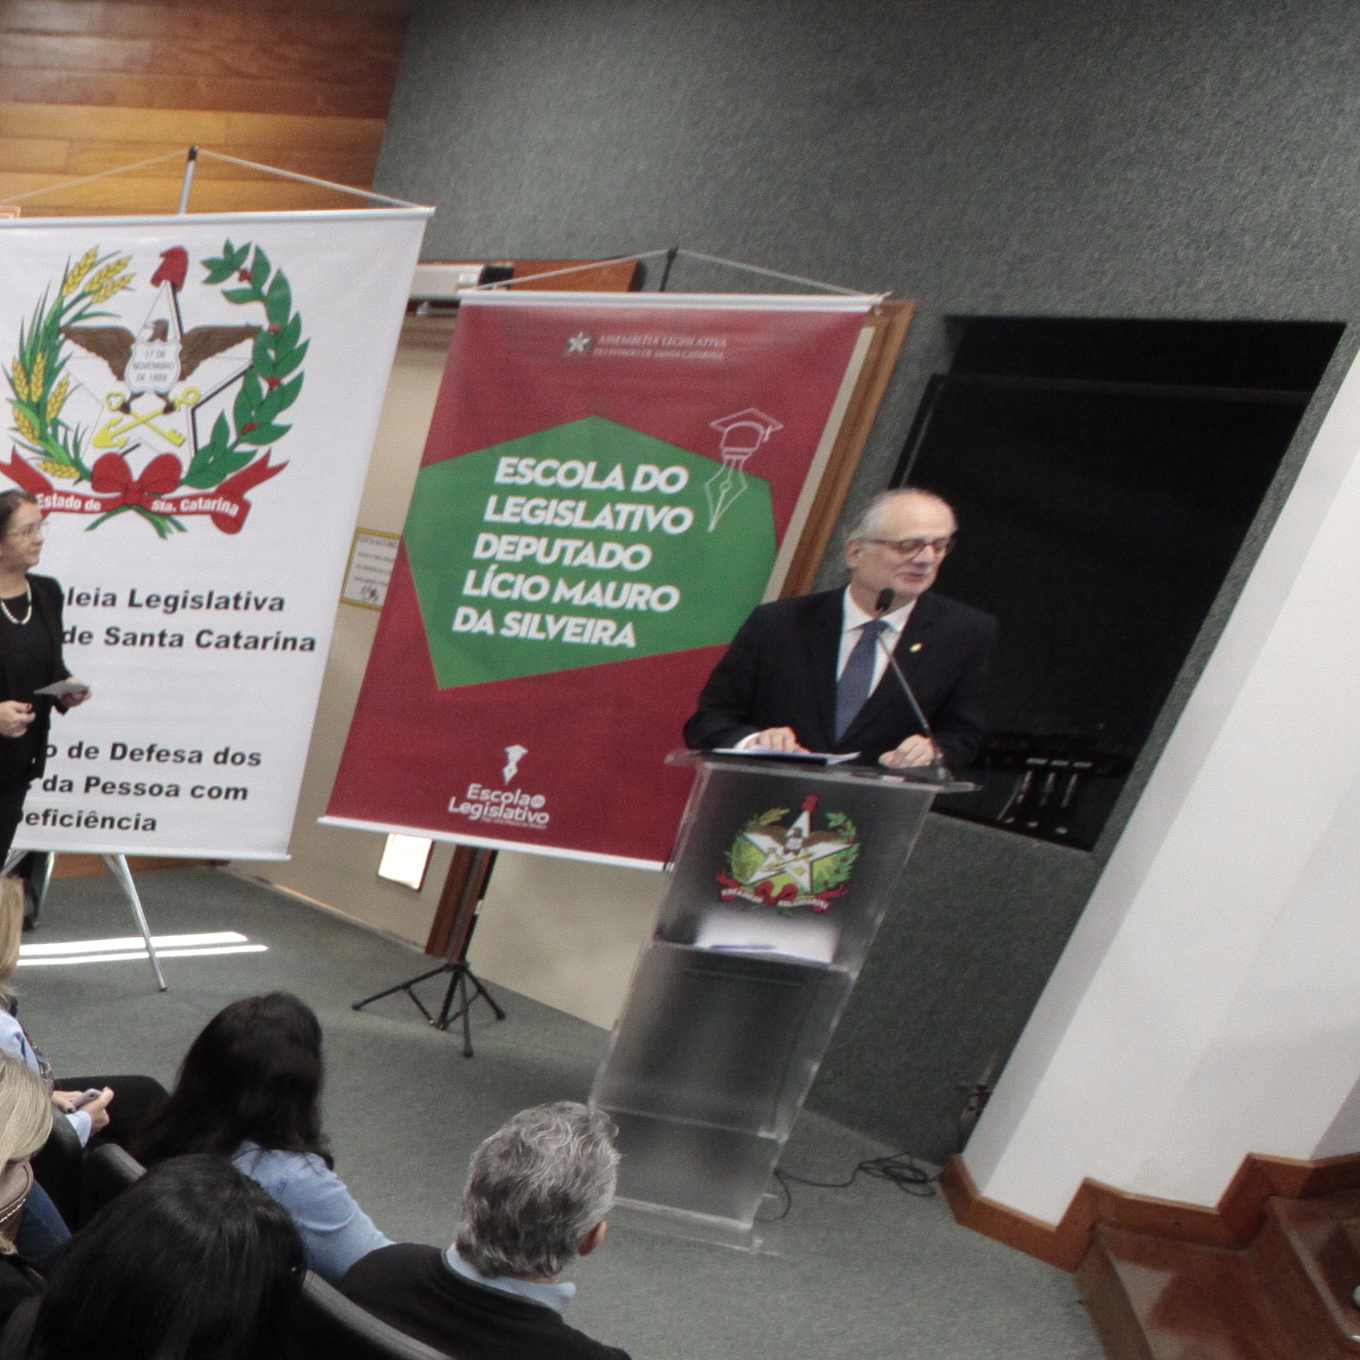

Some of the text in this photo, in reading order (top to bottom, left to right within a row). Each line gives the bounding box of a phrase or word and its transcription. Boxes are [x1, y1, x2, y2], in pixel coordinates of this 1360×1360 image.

[494, 456, 690, 494] ESCOLA DO
[36, 492, 240, 517] Estado de Sta. Catarina
[483, 494, 694, 535] LEGISLATIVO
[472, 532, 654, 572] DEPUTADO
[128, 588, 286, 614] Legislativa
[462, 564, 681, 613] LÍCIO MAURO
[62, 625, 94, 645] de
[104, 626, 183, 648] Santa
[195, 628, 317, 652] Catarina
[452, 606, 637, 648] DA SILVEIRA
[67, 741, 100, 760] de
[109, 742, 203, 763] Defesa
[213, 746, 262, 767] dos
[42, 774, 249, 801] da Pessoa com
[466, 783, 531, 806] Escola
[447, 796, 550, 825] Legislativo
